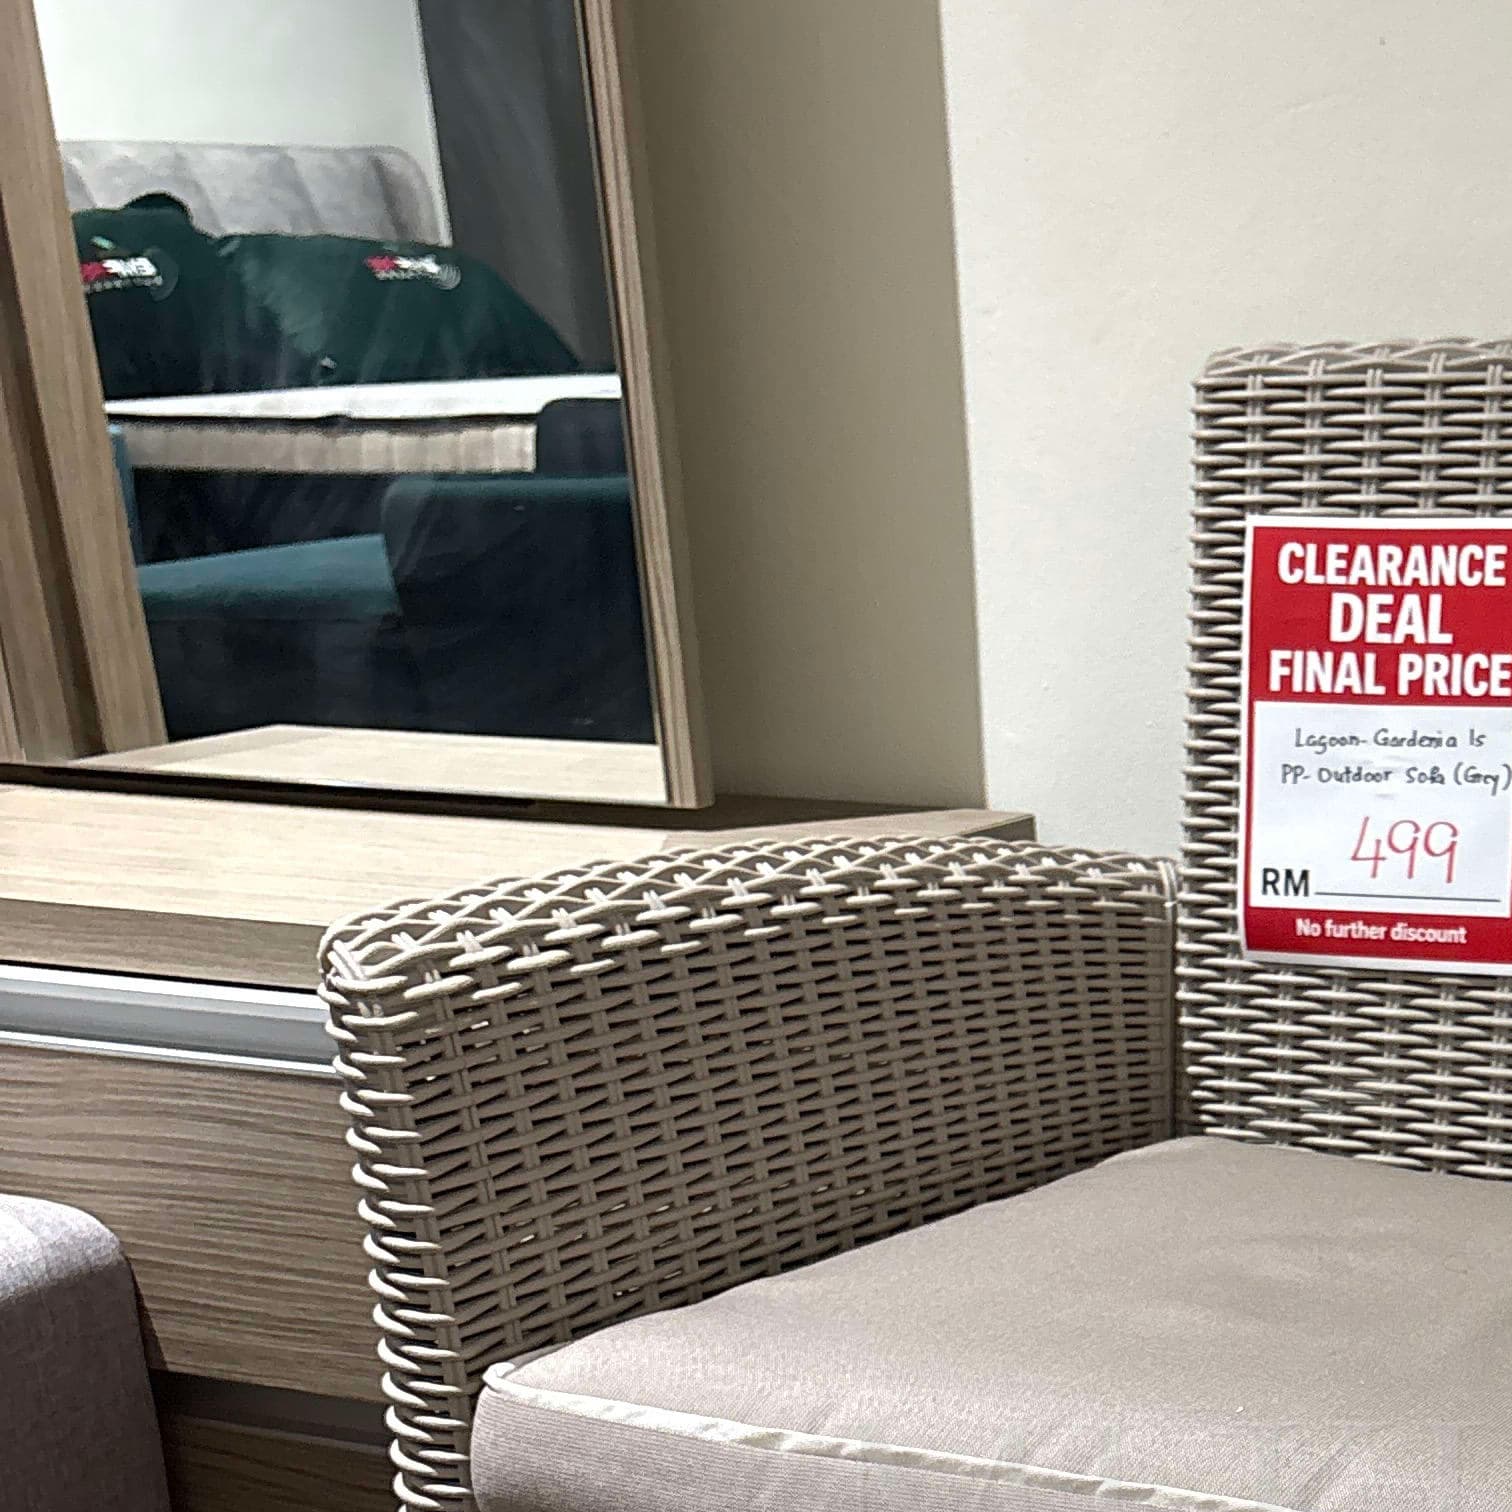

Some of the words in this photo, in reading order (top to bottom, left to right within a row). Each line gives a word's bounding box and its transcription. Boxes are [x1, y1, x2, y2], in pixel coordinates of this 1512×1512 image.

[1278, 542, 1507, 587] CLEARANCE
[1329, 592, 1453, 644] DEAL
[1269, 650, 1386, 695] FINAL
[1405, 766, 1446, 785] Sofa
[1262, 868, 1310, 897] RM
[1351, 816, 1459, 884] 499
[1295, 918, 1322, 937] No
[1324, 919, 1388, 940] further
[1390, 923, 1467, 944] discount
